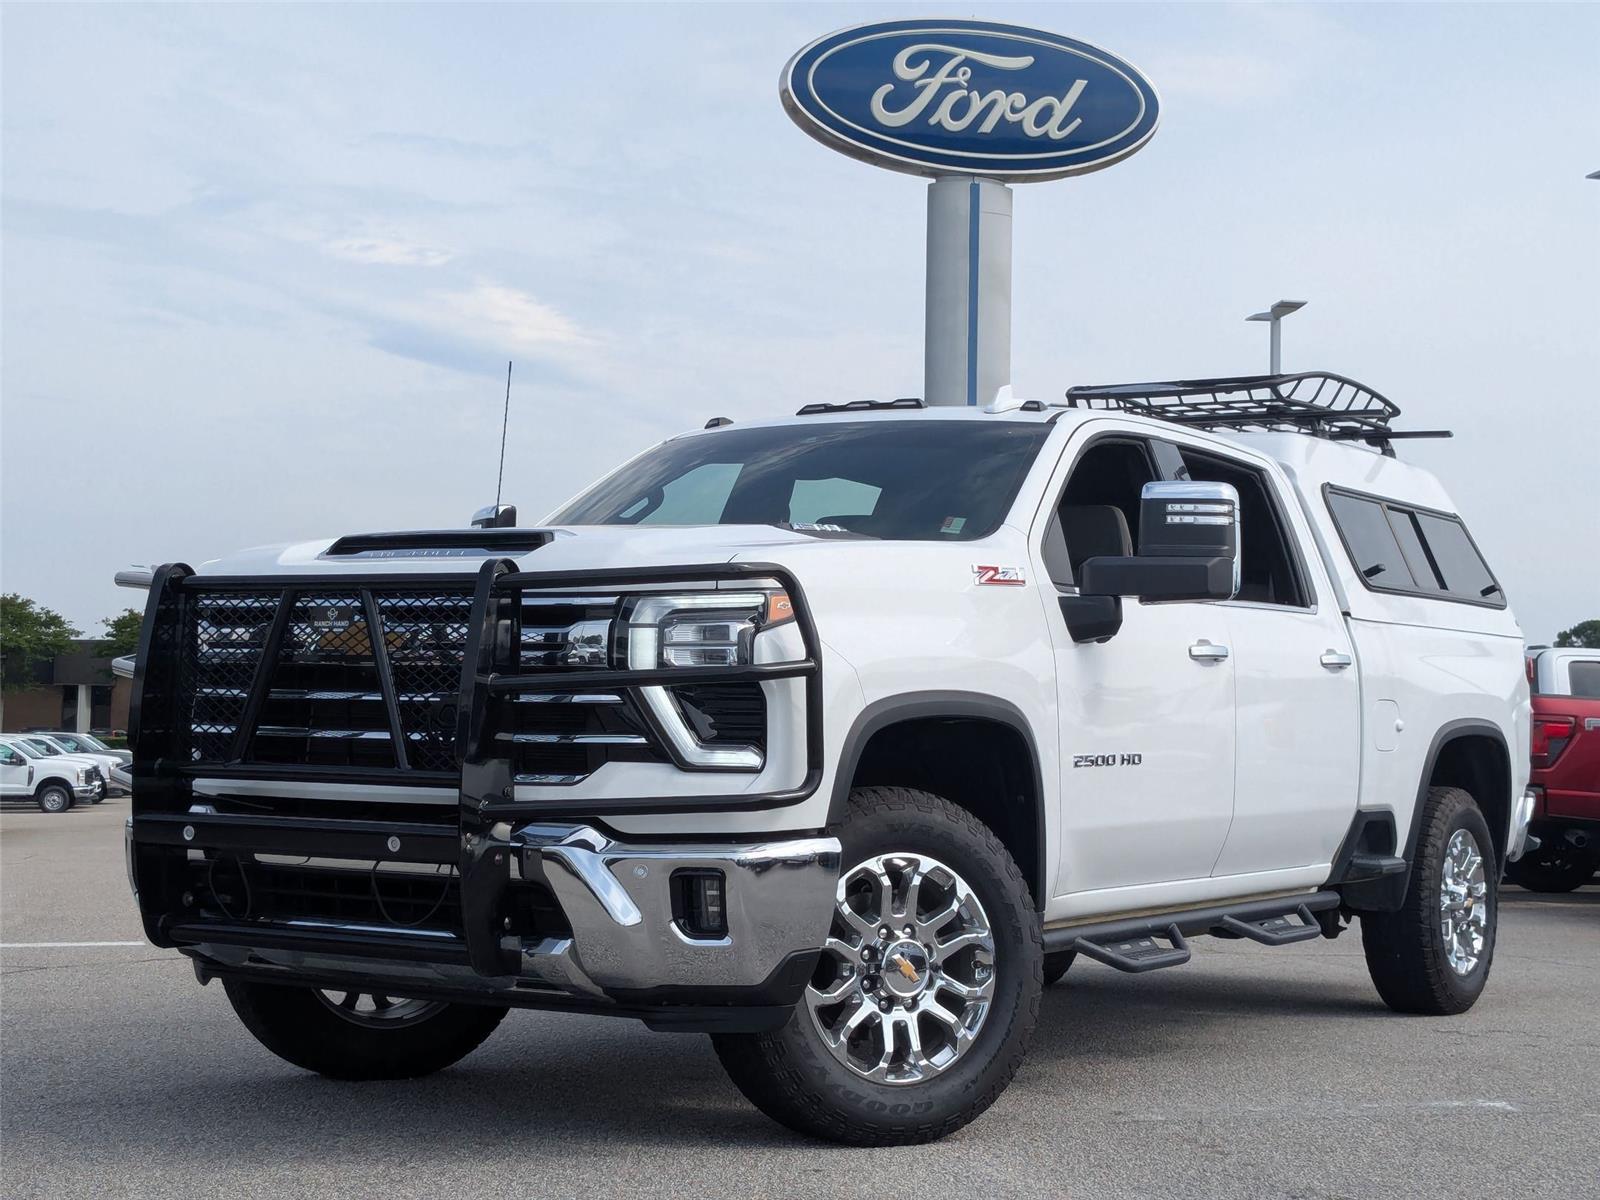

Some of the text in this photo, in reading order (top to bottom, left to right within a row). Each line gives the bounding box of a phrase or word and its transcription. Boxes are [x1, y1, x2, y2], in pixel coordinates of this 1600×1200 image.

[870, 43, 1088, 141] Ford
[971, 564, 1026, 587] Z71
[1073, 752, 1142, 769] 2500 HD
